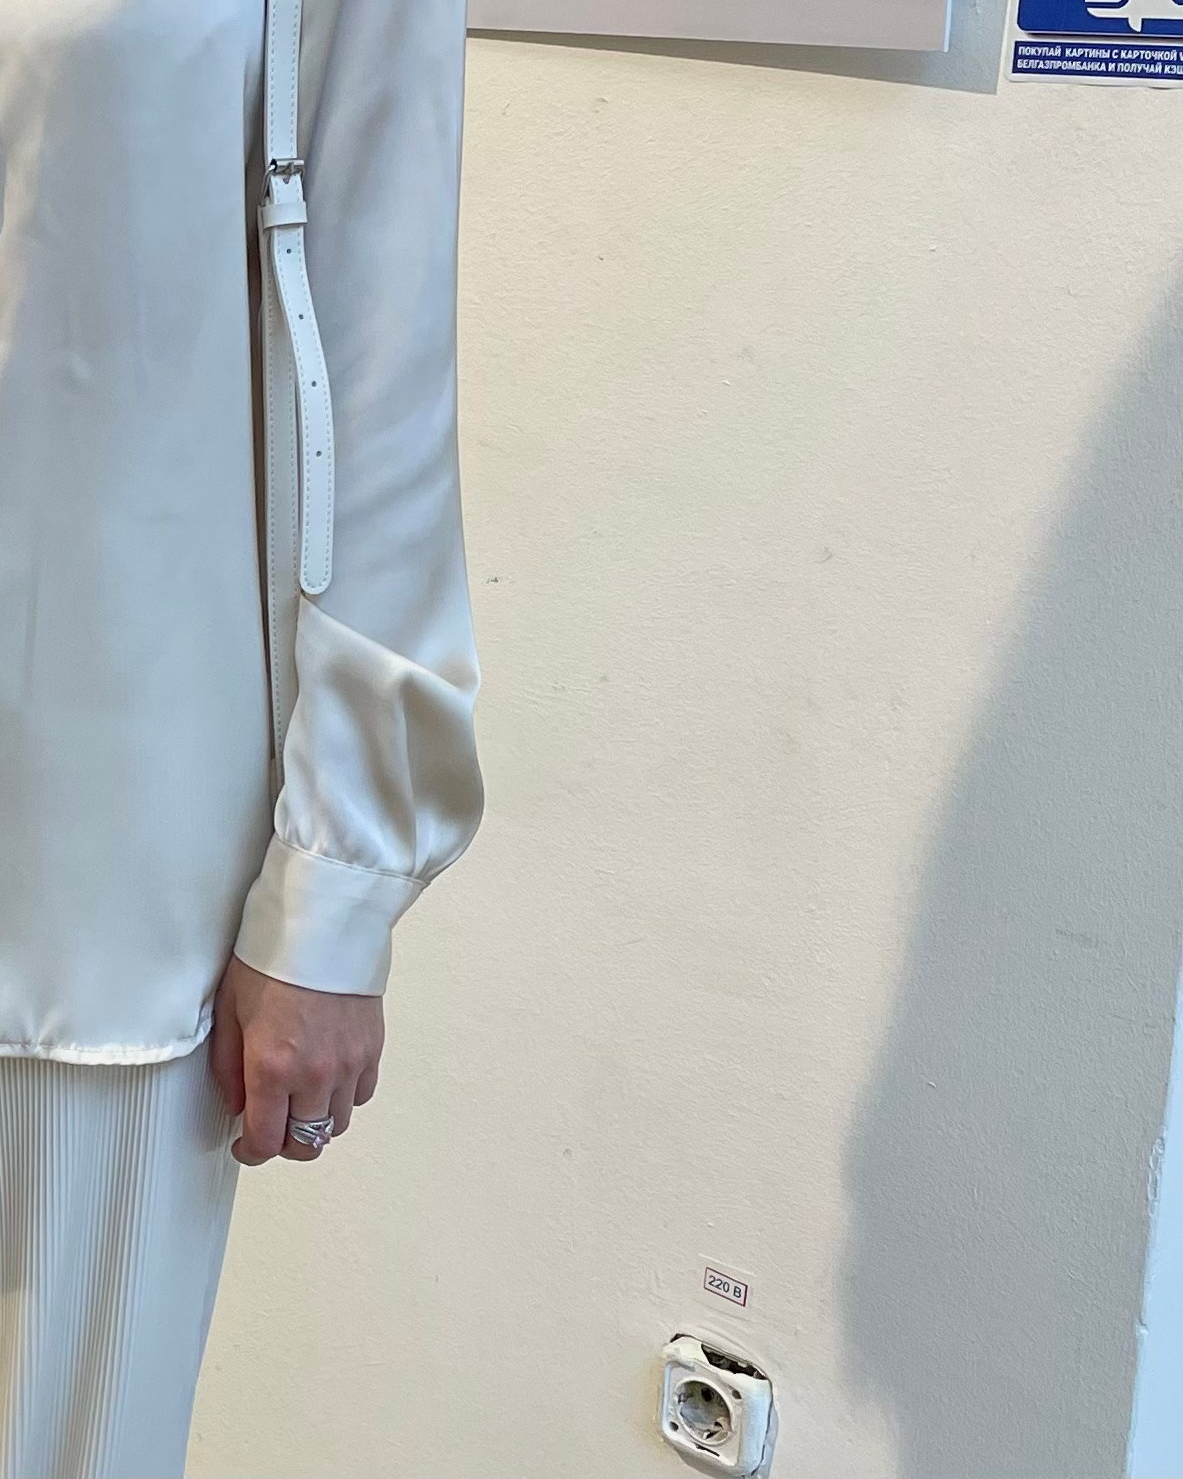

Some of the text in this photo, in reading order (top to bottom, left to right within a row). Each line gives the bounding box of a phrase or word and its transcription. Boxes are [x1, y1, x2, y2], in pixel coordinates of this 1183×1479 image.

[1018, 45, 1061, 56] ПОКУПАЙ
[1065, 48, 1110, 58] КАРТИНЫ
[1112, 50, 1118, 59] С
[1120, 49, 1177, 61] КАРТОЧКОЙ
[1017, 59, 1106, 71] БЕЛГАЗПРОМБАНКА
[1108, 62, 1115, 71] И
[1118, 62, 1161, 74] ПОЛУЧАЙ
[709, 1274, 742, 1298] 220 В
